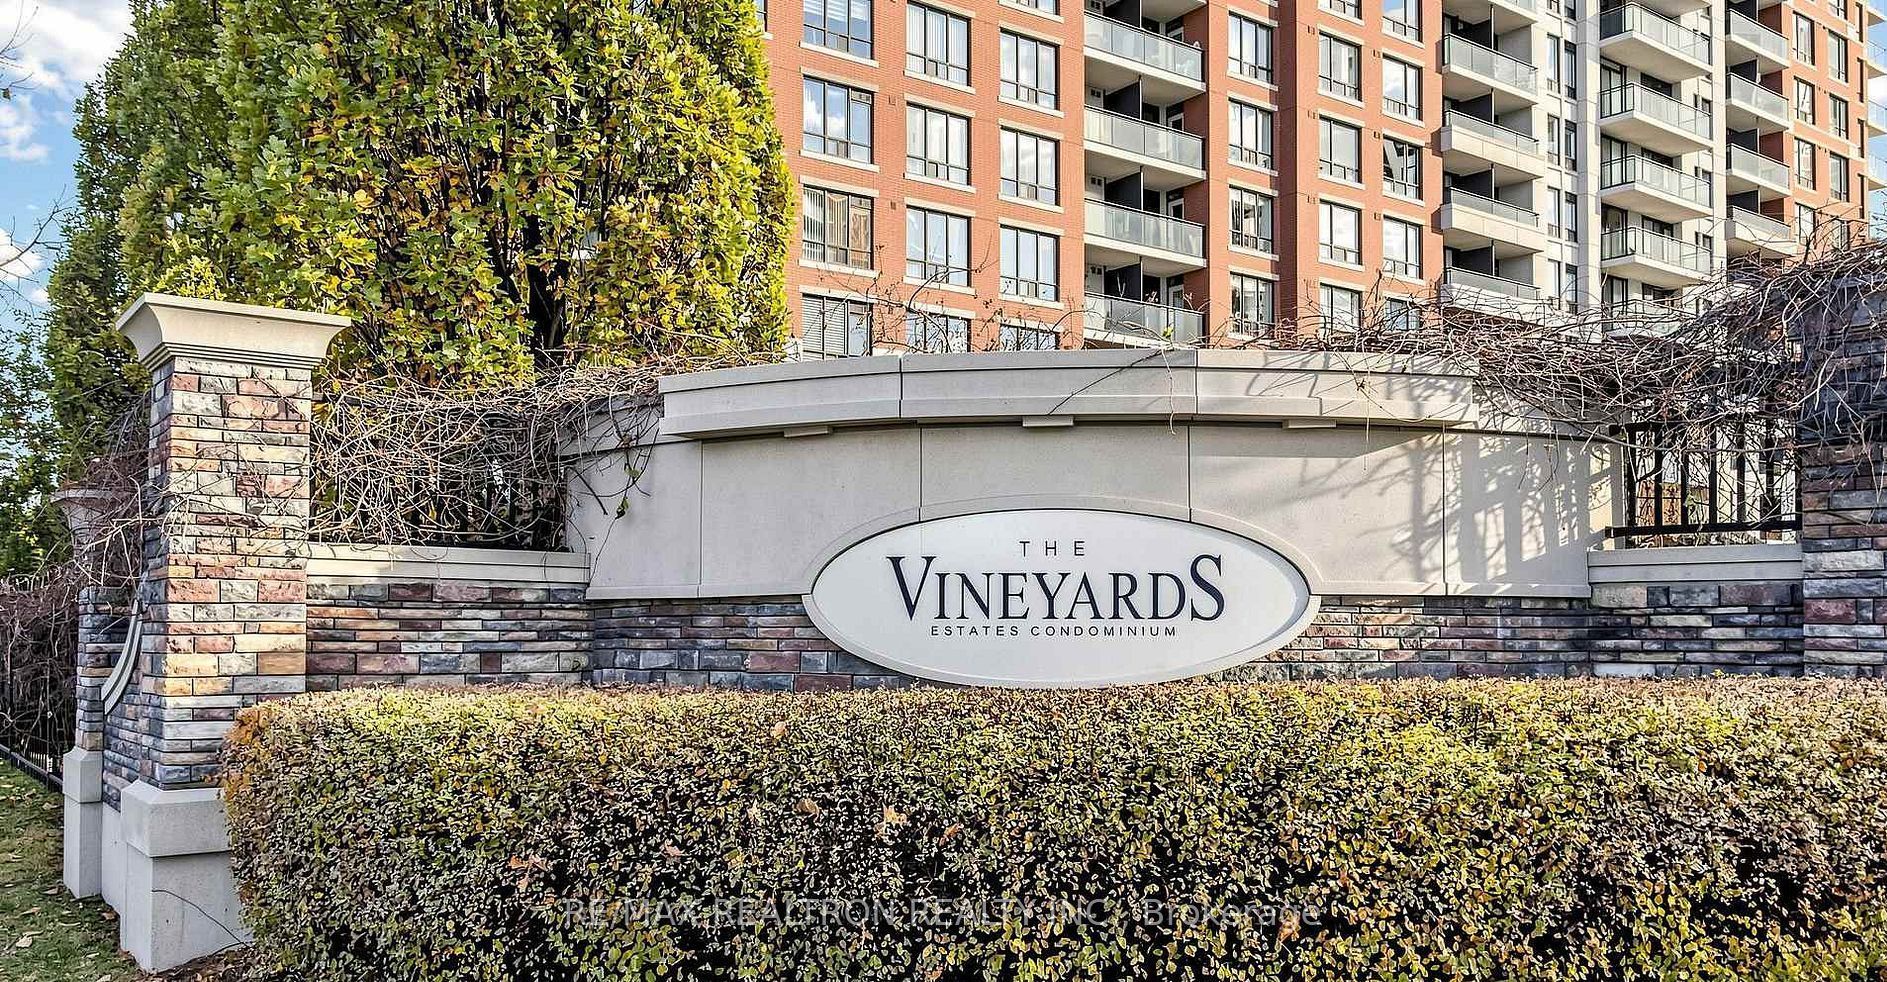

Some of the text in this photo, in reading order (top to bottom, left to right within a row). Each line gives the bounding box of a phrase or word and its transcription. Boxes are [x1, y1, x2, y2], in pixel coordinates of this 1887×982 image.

[1019, 540, 1085, 557] THE
[886, 554, 1225, 622] VINEYARDS
[931, 625, 1177, 637] ESTATES CONDOMINIUM
